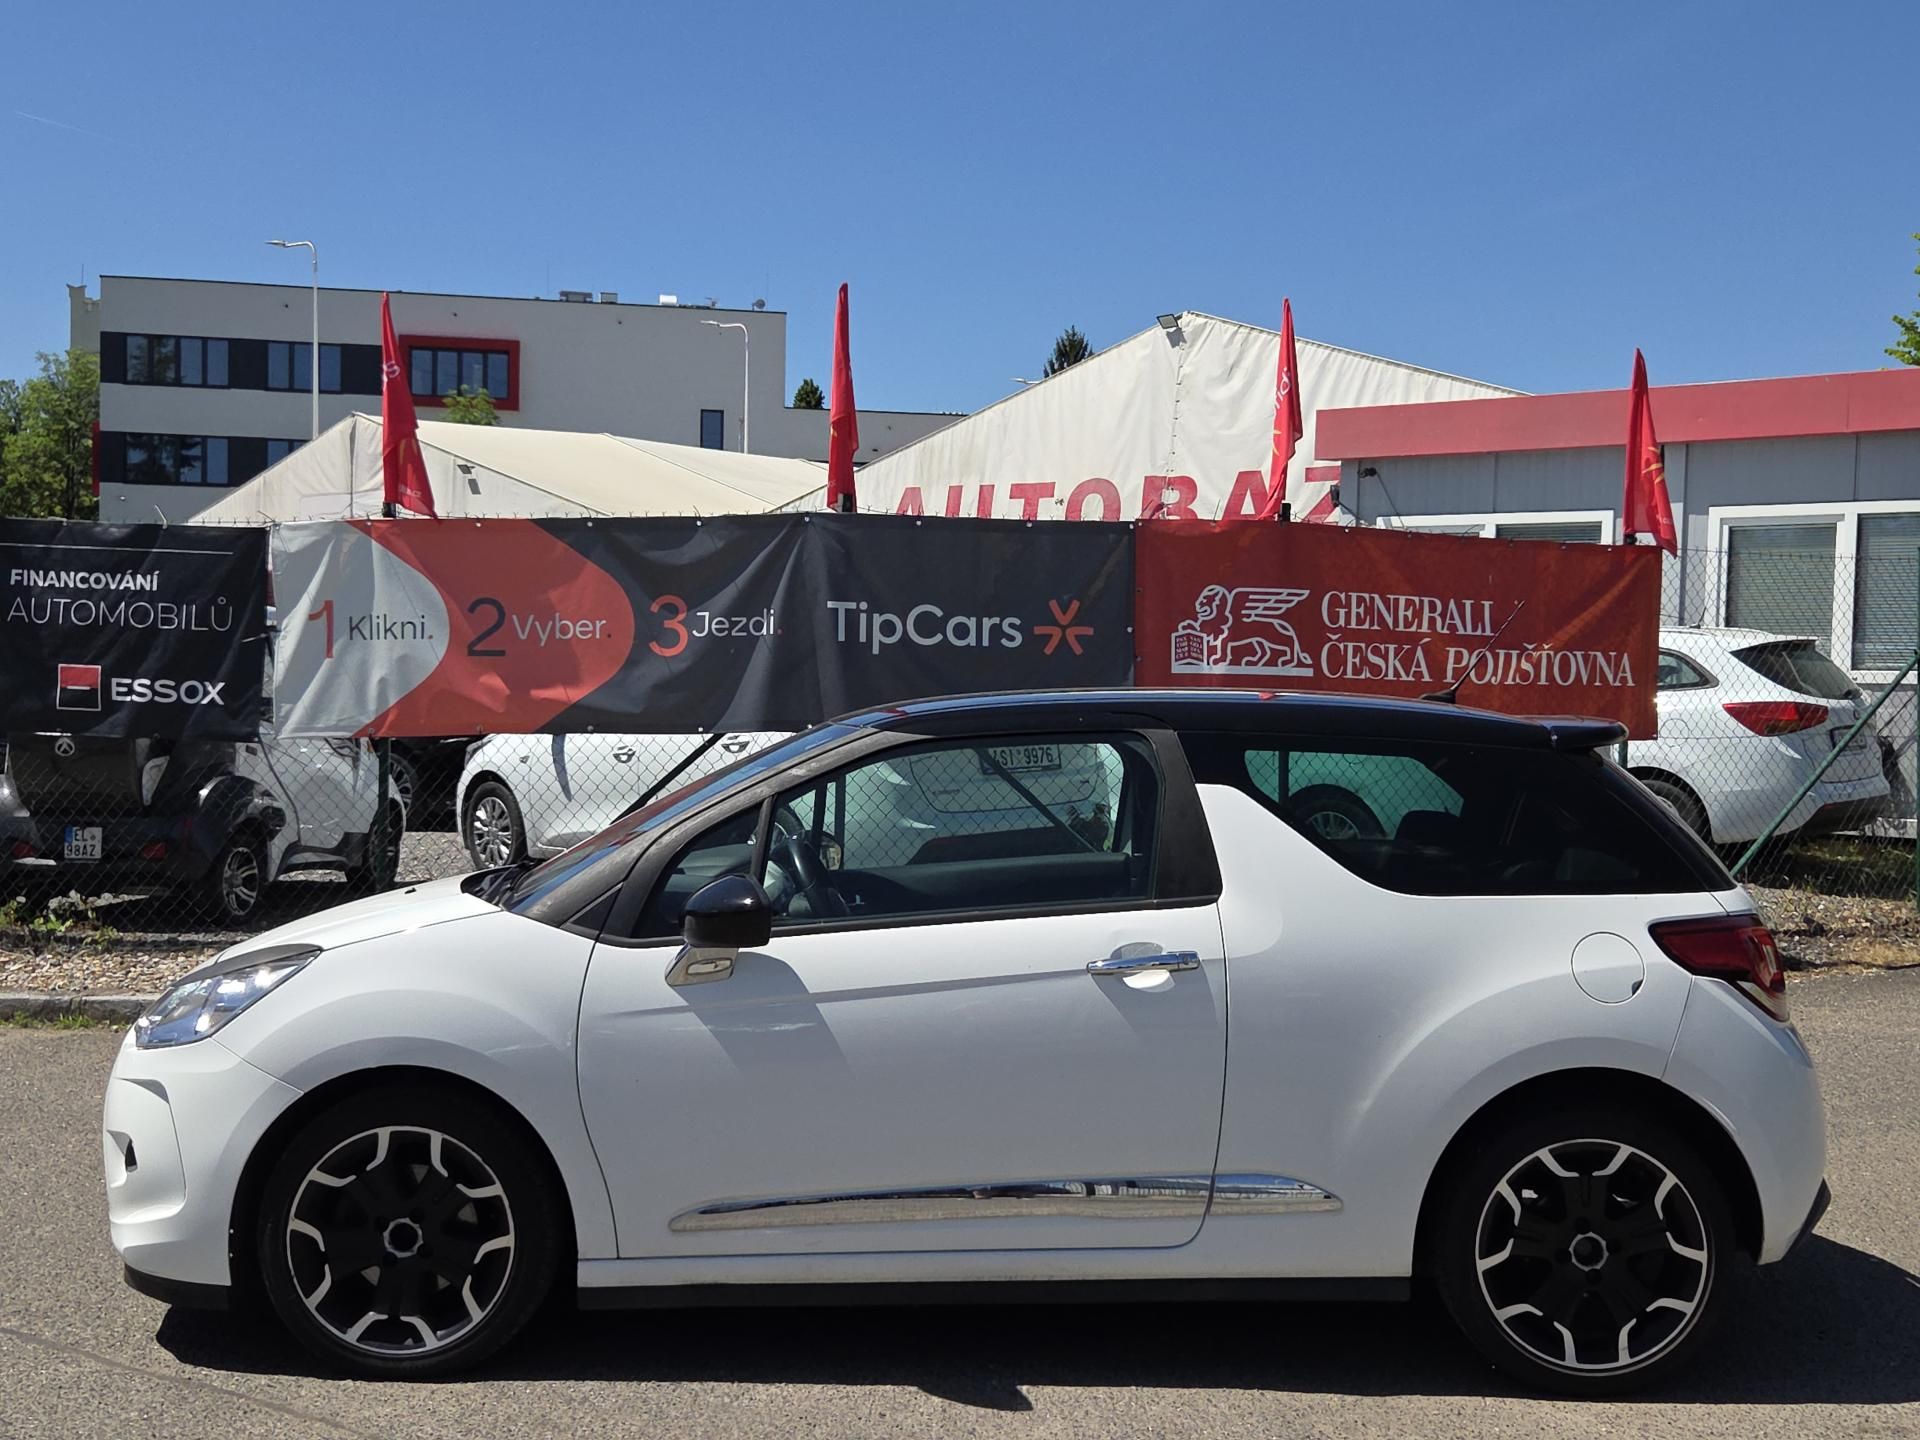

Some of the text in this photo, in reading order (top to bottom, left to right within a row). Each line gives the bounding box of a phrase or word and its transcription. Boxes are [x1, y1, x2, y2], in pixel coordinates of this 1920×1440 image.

[9, 568, 161, 592] FINANCOVÁNÍ
[6, 596, 234, 632] AUTOMOBILŮ
[308, 599, 434, 659] 1 Klikni.
[467, 597, 612, 657] 2 Vyber.
[648, 594, 783, 657] 3 Jezdi.
[826, 600, 1023, 655] TipCars
[1321, 590, 1495, 637] GENERALI
[1320, 633, 1636, 687] ČESKÁ POJIŠŤOVNA
[111, 677, 226, 705] ESSOX
